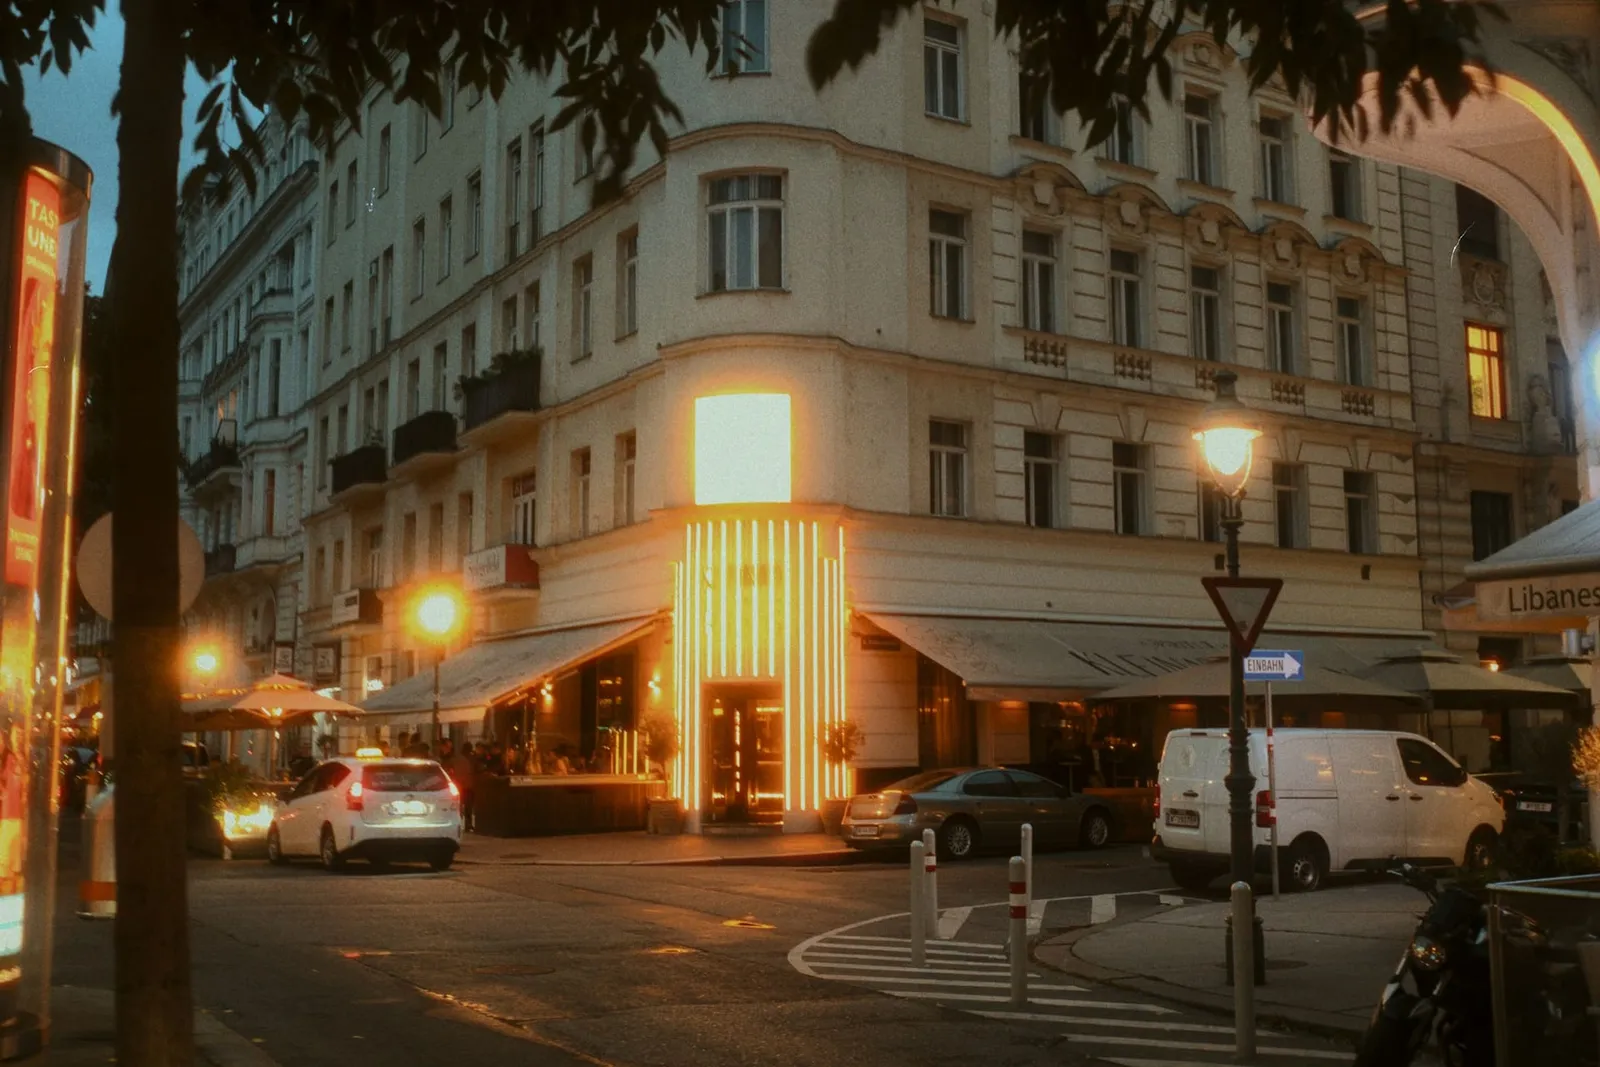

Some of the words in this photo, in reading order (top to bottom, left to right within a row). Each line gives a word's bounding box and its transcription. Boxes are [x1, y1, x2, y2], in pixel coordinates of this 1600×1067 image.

[29, 196, 58, 230] TAS
[1508, 583, 1600, 612] Libanes
[1247, 659, 1284, 671] EINBAHN
